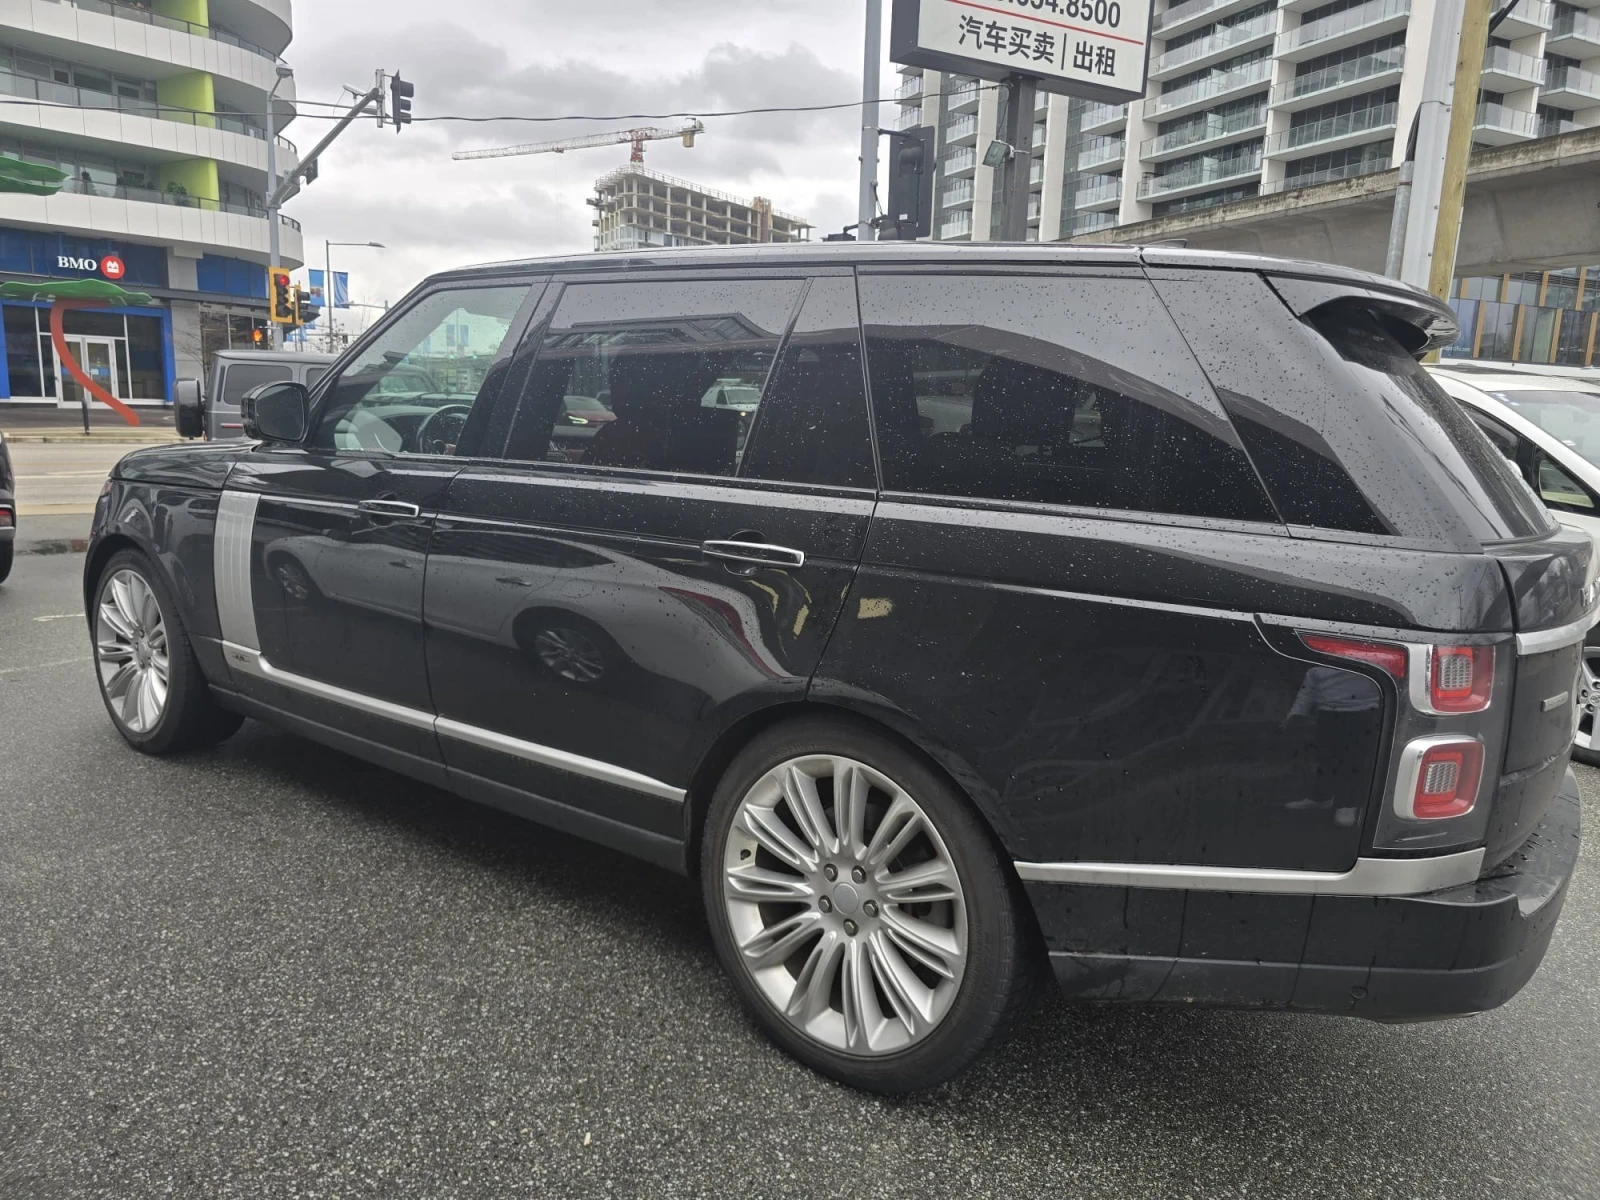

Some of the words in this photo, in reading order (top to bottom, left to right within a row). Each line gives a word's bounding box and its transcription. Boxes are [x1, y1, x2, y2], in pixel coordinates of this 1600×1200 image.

[958, 14, 1055, 64] 汽车买卖
[1073, 40, 1116, 77] 出租
[57, 255, 97, 271] BMO
